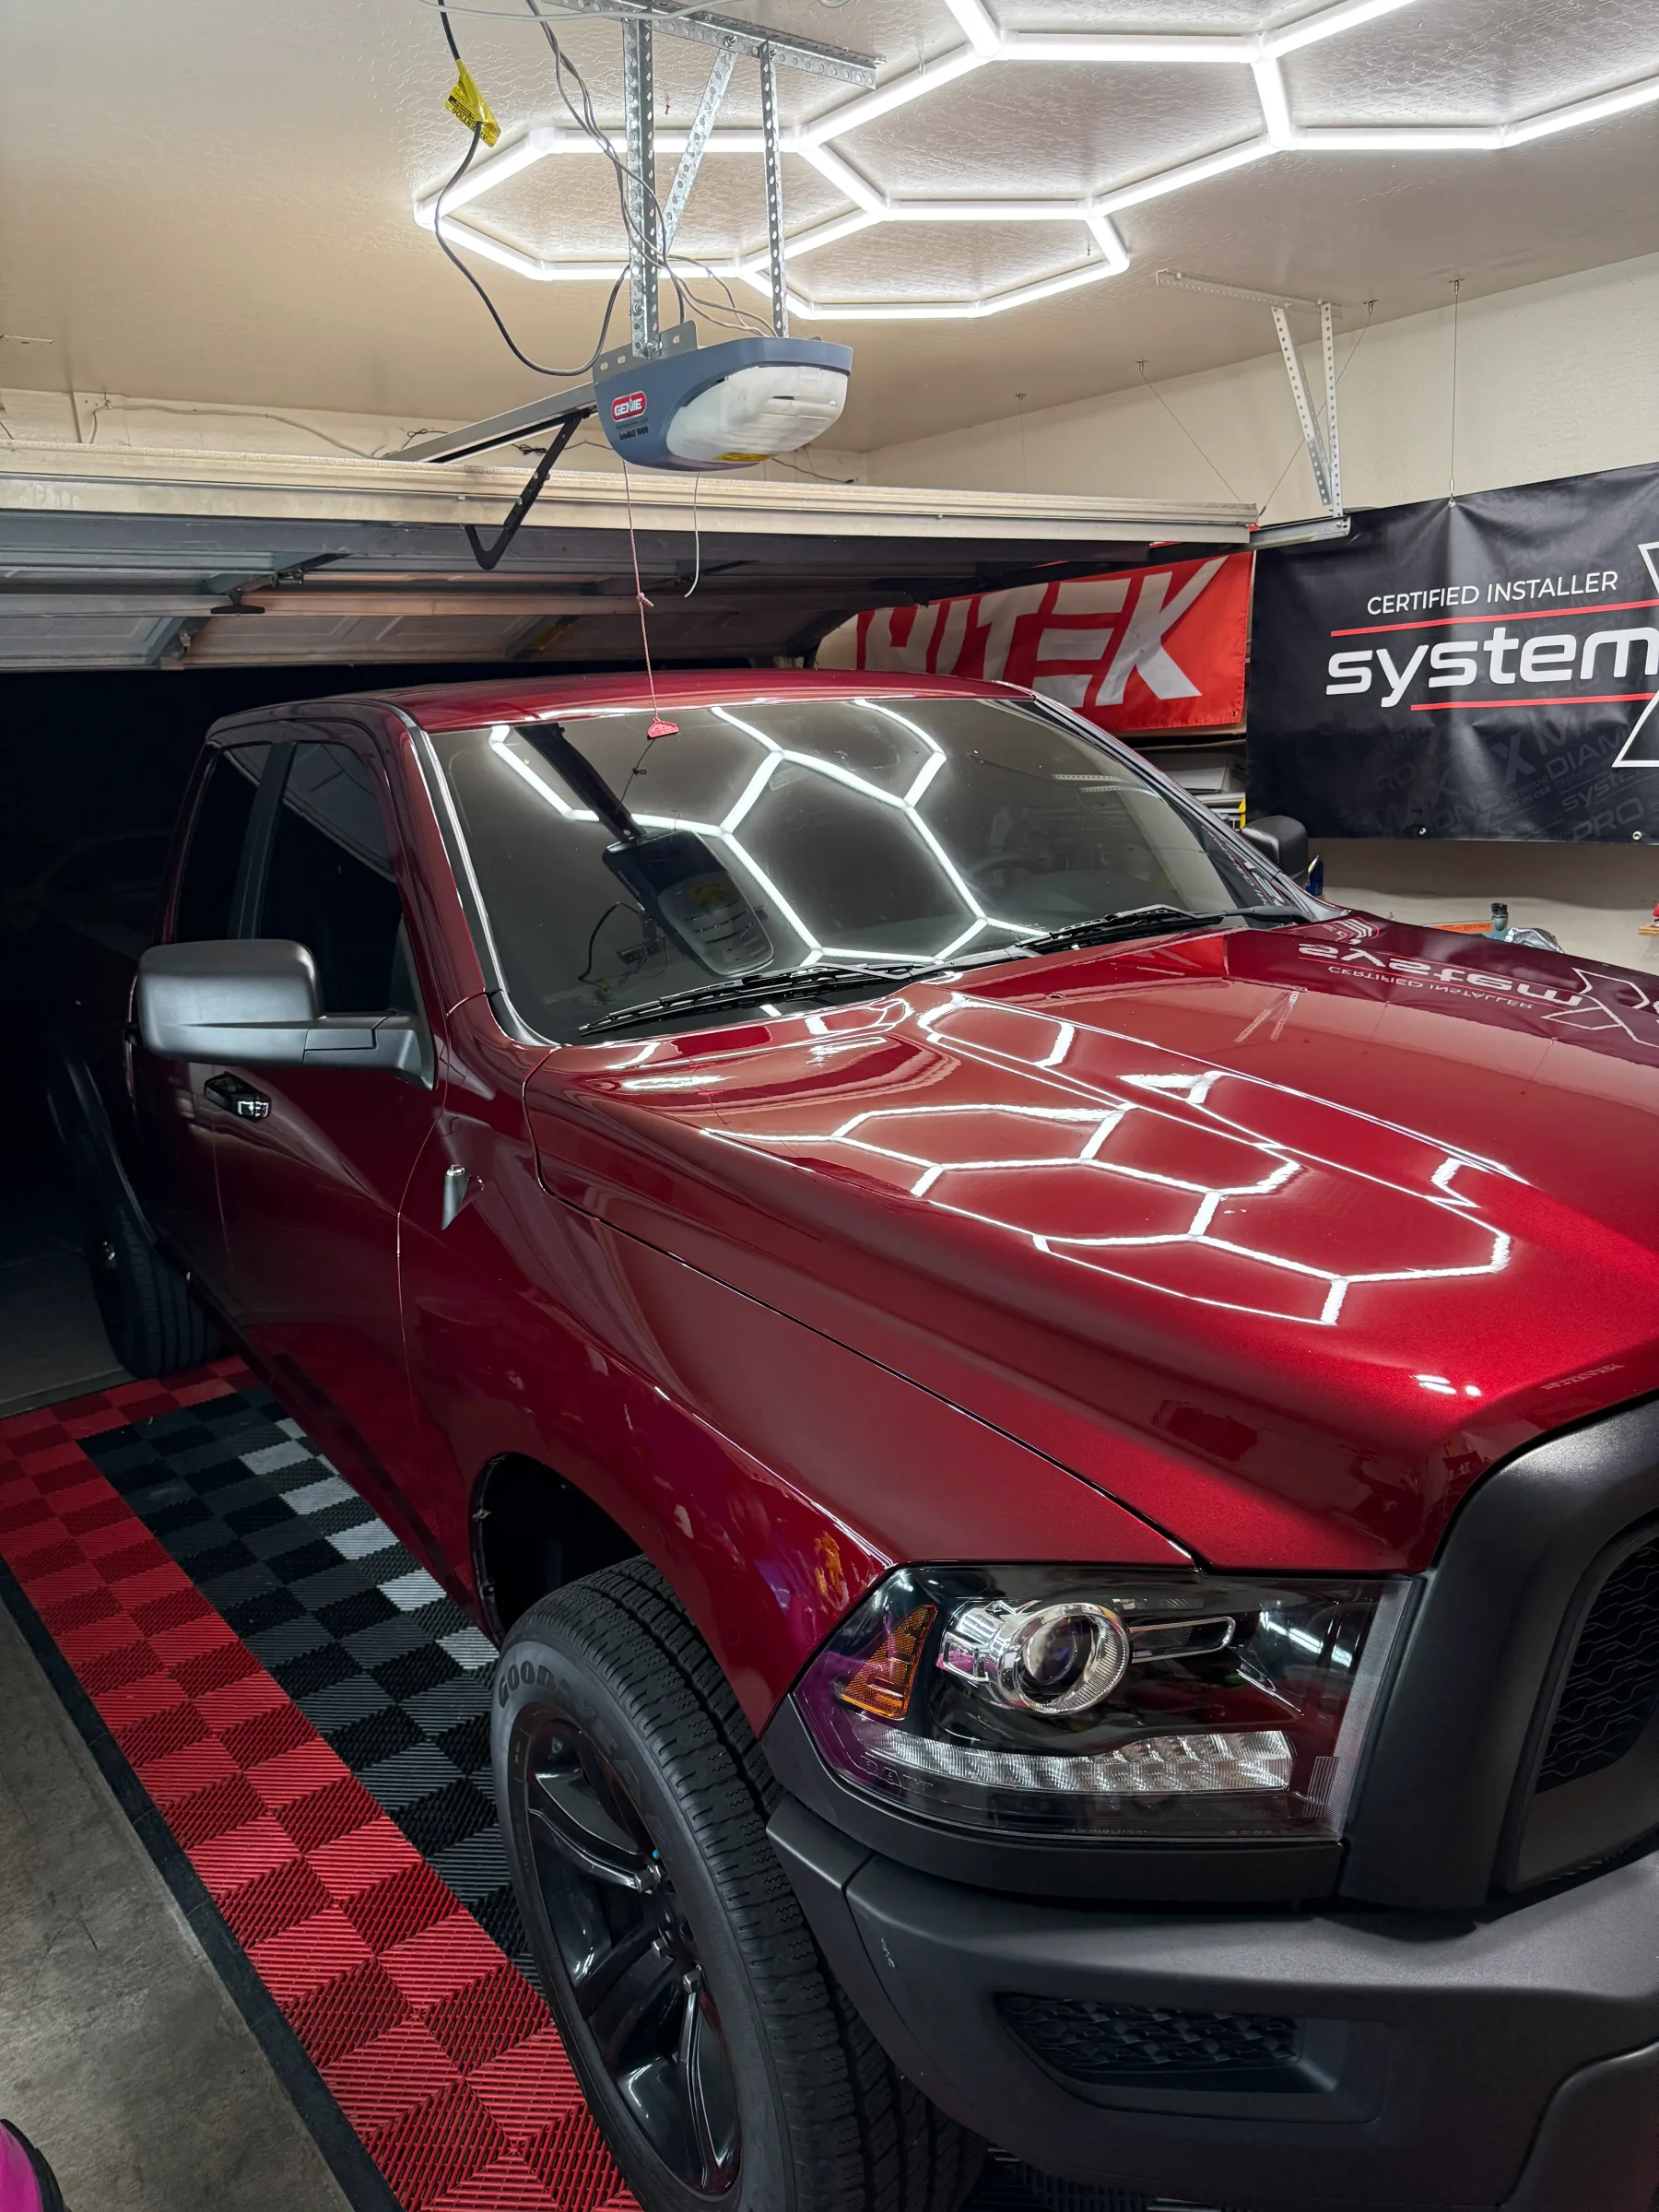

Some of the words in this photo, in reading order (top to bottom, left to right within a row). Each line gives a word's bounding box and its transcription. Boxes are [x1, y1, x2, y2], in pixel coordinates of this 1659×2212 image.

[614, 396, 643, 417] GENIE
[1367, 585, 1480, 616] CERTIFIED
[1487, 571, 1618, 604] INSTALLER
[1325, 627, 1659, 708] system
